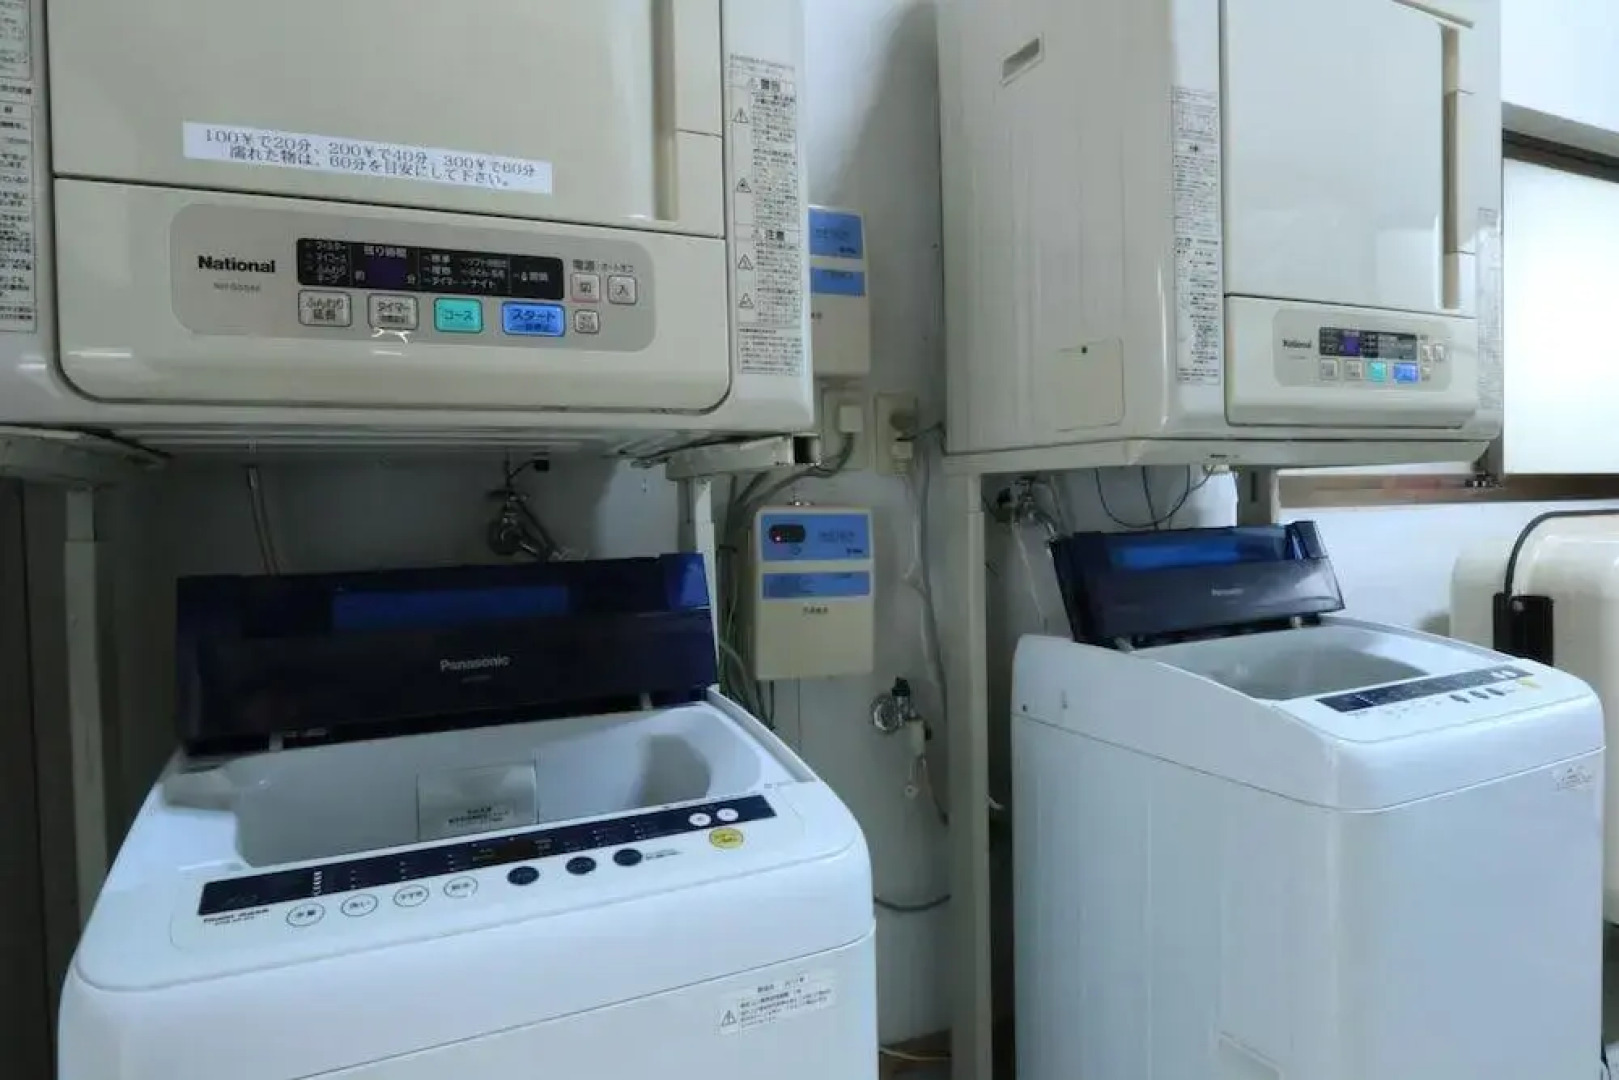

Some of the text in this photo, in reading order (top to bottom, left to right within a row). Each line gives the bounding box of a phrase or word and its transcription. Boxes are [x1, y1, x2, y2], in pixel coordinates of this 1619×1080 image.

[198, 255, 276, 273] National
[443, 310, 474, 321] コース
[512, 309, 555, 323] スタート
[439, 656, 511, 673] Panasonic
